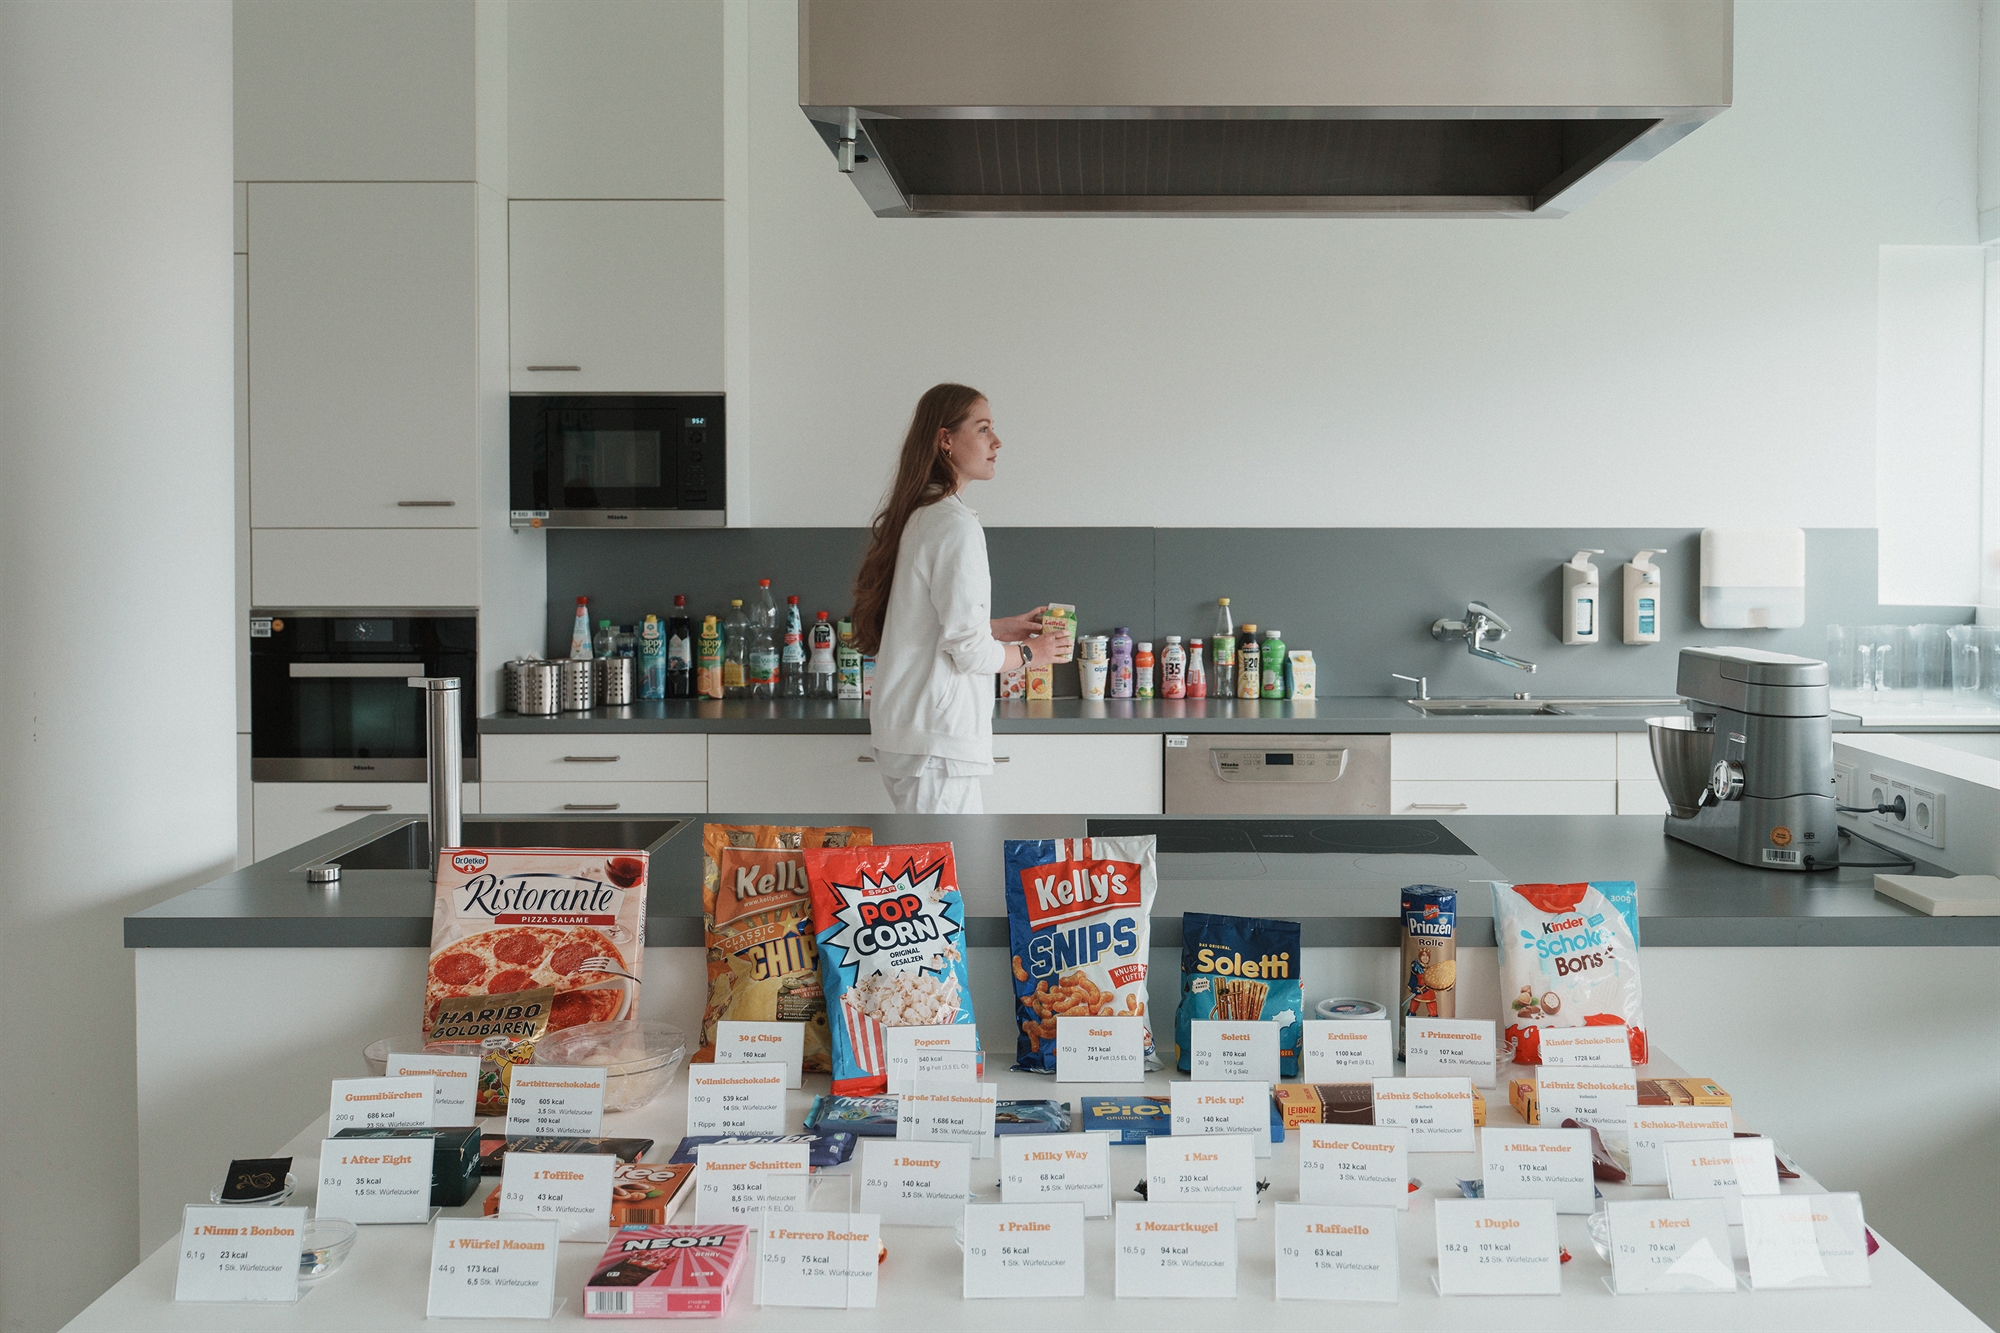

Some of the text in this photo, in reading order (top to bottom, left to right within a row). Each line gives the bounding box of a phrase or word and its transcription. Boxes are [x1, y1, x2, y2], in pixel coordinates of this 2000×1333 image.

[643, 646, 659, 656] day
[702, 647, 718, 656] day
[1169, 663, 1180, 674] 35
[867, 886, 896, 895] SPAR
[1034, 865, 1127, 911] Kelly's
[463, 874, 613, 915] Ristorante
[1611, 895, 1631, 904] 300g
[743, 893, 788, 908] www.kellys.eu
[860, 896, 920, 926] POP
[1410, 918, 1451, 935] Prinzen
[725, 925, 776, 949] CLASSIC
[856, 917, 936, 953] CORN
[1029, 917, 1139, 978] SNIPS
[1418, 939, 1444, 947] Rolle
[890, 948, 920, 959] ORIGINAL
[890, 955, 923, 967] GESALZEN
[1197, 949, 1289, 978] Soletti
[1554, 952, 1603, 976] Bons
[439, 1003, 542, 1025] HARIBO
[758, 1034, 782, 1043] Chips
[1089, 1029, 1112, 1038] Snips
[1428, 1031, 1482, 1040] Prinzenrolle
[1546, 1037, 1624, 1046] Kinder Schoko-Bons
[400, 1068, 467, 1078] Gummibärchen
[516, 1080, 600, 1089] Zartbitterschokolade
[696, 1077, 780, 1085] Vollmilchschokolade
[1540, 1081, 1635, 1090] Leibniz Schokokeks
[345, 1091, 422, 1101] Gummibärchen
[951, 1095, 994, 1104] Schokolade
[1376, 1091, 1470, 1100] Leibniz Schokokeks
[1205, 1096, 1227, 1104] Pick
[1229, 1096, 1244, 1106] up!
[1288, 1107, 1316, 1115] LEIBNIZ
[1641, 1121, 1728, 1130] Schoko-Reiswaffel
[1312, 1140, 1395, 1153] Kinder Country
[1511, 1144, 1537, 1152] Milka
[1539, 1144, 1571, 1153] Tender
[350, 1156, 379, 1164] After
[382, 1155, 412, 1165] Eight
[1032, 1151, 1062, 1162] Milky
[1065, 1150, 1088, 1160] Way
[1192, 1152, 1218, 1161] Mars
[706, 1161, 802, 1171] Manner Schnitten
[902, 1158, 941, 1169] Bounty
[541, 1171, 584, 1180] Toffifee
[999, 1222, 1051, 1232] 1 Praline
[1135, 1221, 1218, 1234] 1 Mozartkugel
[1475, 1219, 1520, 1230] 1 Duplo
[1658, 1219, 1690, 1228] Merci
[193, 1226, 295, 1236] 1 Nimm 2 Bonbon
[1306, 1223, 1369, 1235] 1 Raffaello
[769, 1230, 869, 1241] 1 Ferrero Rocher
[449, 1238, 544, 1251] 1 Würfel Maoam
[623, 1236, 726, 1251] NEOH
[232, 1251, 248, 1259] kcal
[482, 1265, 499, 1273] kcal
